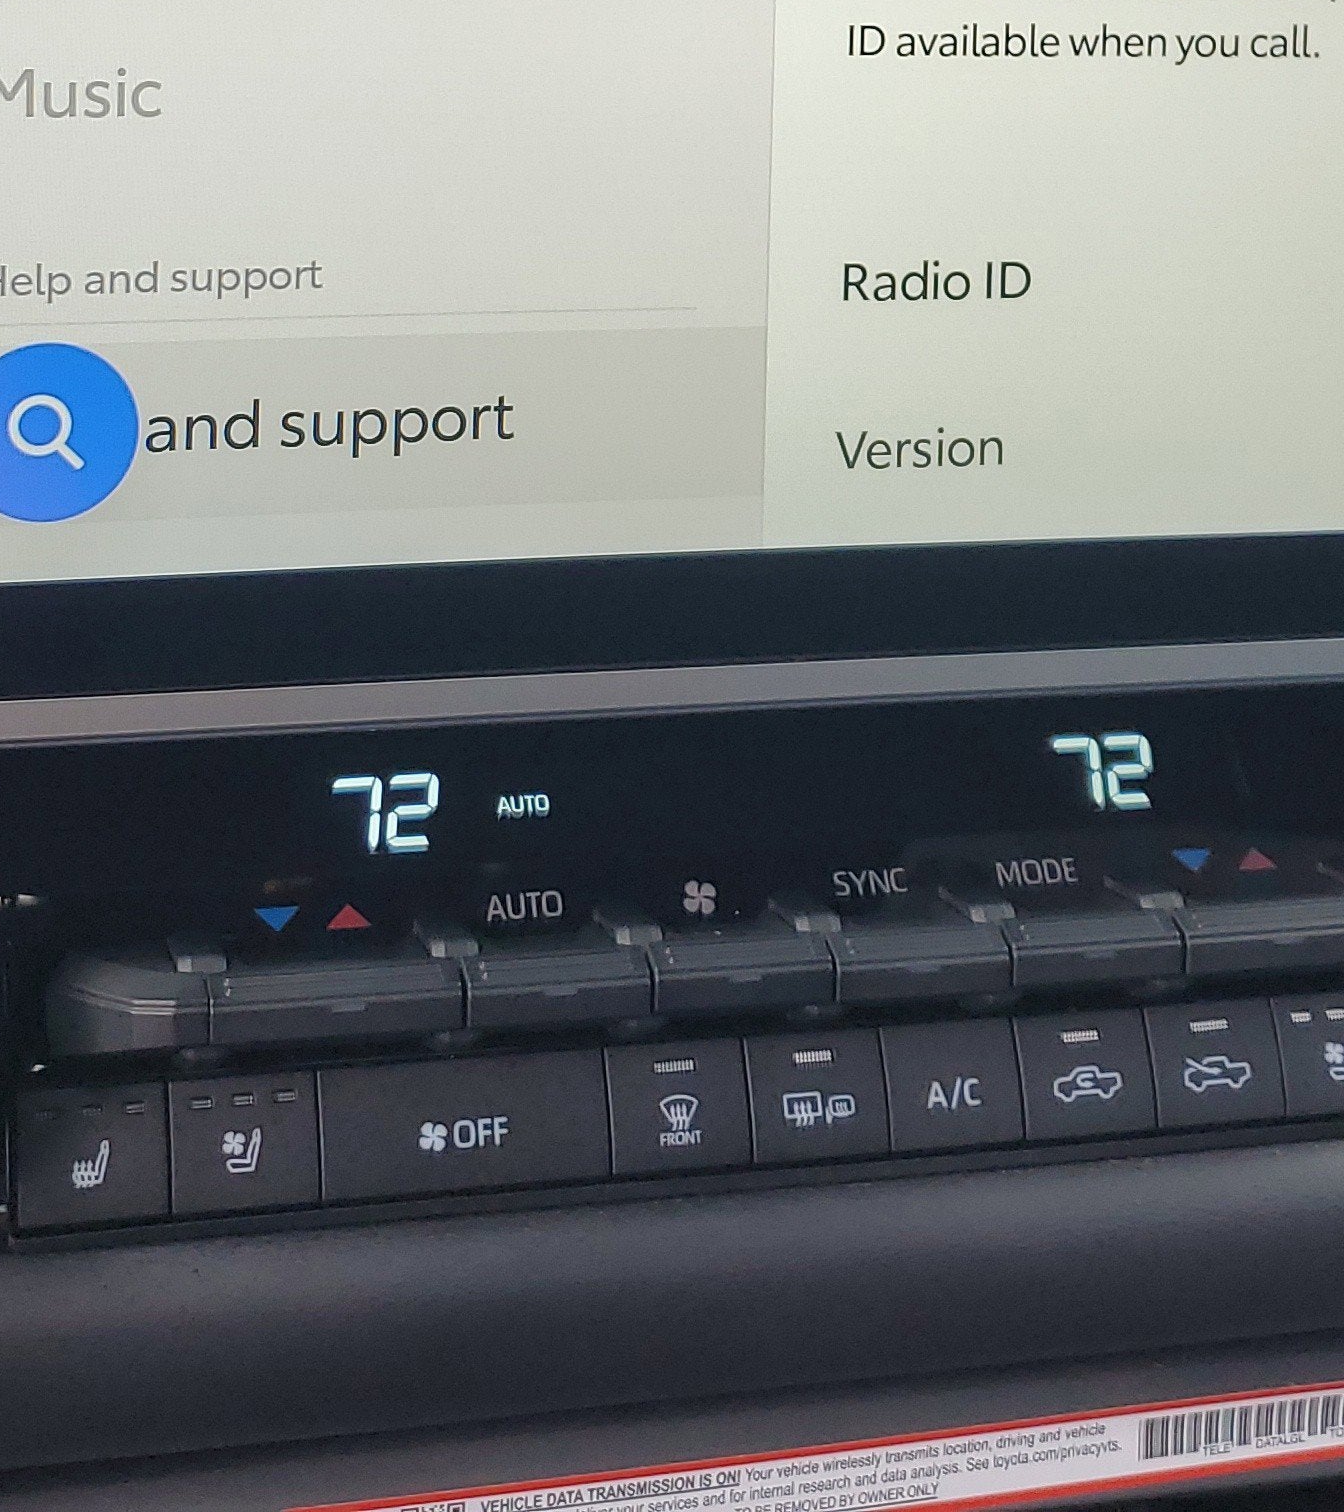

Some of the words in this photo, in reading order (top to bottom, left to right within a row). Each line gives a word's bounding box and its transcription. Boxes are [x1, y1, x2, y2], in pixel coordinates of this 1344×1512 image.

[848, 24, 886, 57] ID
[896, 22, 1060, 58] available
[1068, 23, 1167, 58] when
[1175, 34, 1240, 66] you
[1250, 24, 1320, 58] call.
[84, 260, 159, 295] and
[170, 260, 323, 300] support
[843, 260, 971, 302] Radio
[986, 261, 1032, 299] ID
[144, 398, 260, 453] and
[280, 395, 515, 459] support
[835, 426, 1003, 470] Version
[1051, 732, 1153, 809] 72
[332, 772, 440, 853] 72
[496, 793, 550, 817] AUTO
[832, 867, 908, 897] SYNC
[995, 857, 1078, 887] MODE
[486, 890, 563, 922] AUTO
[927, 1077, 981, 1110] A/C
[453, 1116, 509, 1149] OFF
[659, 1130, 702, 1147] FRONT
[480, 1494, 543, 1512] VEHICLE
[546, 1488, 584, 1506] DATA
[587, 1475, 695, 1502] TRANSMISSION
[699, 1473, 712, 1487] IS
[716, 1469, 742, 1486] ON!
[745, 1465, 775, 1483] Your
[777, 1458, 819, 1477] vehicle
[822, 1450, 881, 1472] wirelessly
[885, 1445, 940, 1465] transmits
[943, 1438, 992, 1456] location,
[996, 1432, 1036, 1450] driving
[1039, 1428, 1061, 1443] and
[1065, 1421, 1106, 1439] vehicle
[647, 1496, 699, 1512] services
[702, 1490, 727, 1506] and
[729, 1487, 747, 1503] for
[749, 1482, 794, 1501] internal
[798, 1476, 851, 1494] research
[854, 1471, 878, 1487] and
[881, 1465, 907, 1483] data
[966, 1455, 989, 1472] See
[839, 1492, 855, 1507] BY
[858, 1486, 905, 1504] OWNER
[907, 1482, 940, 1499] ONLY
